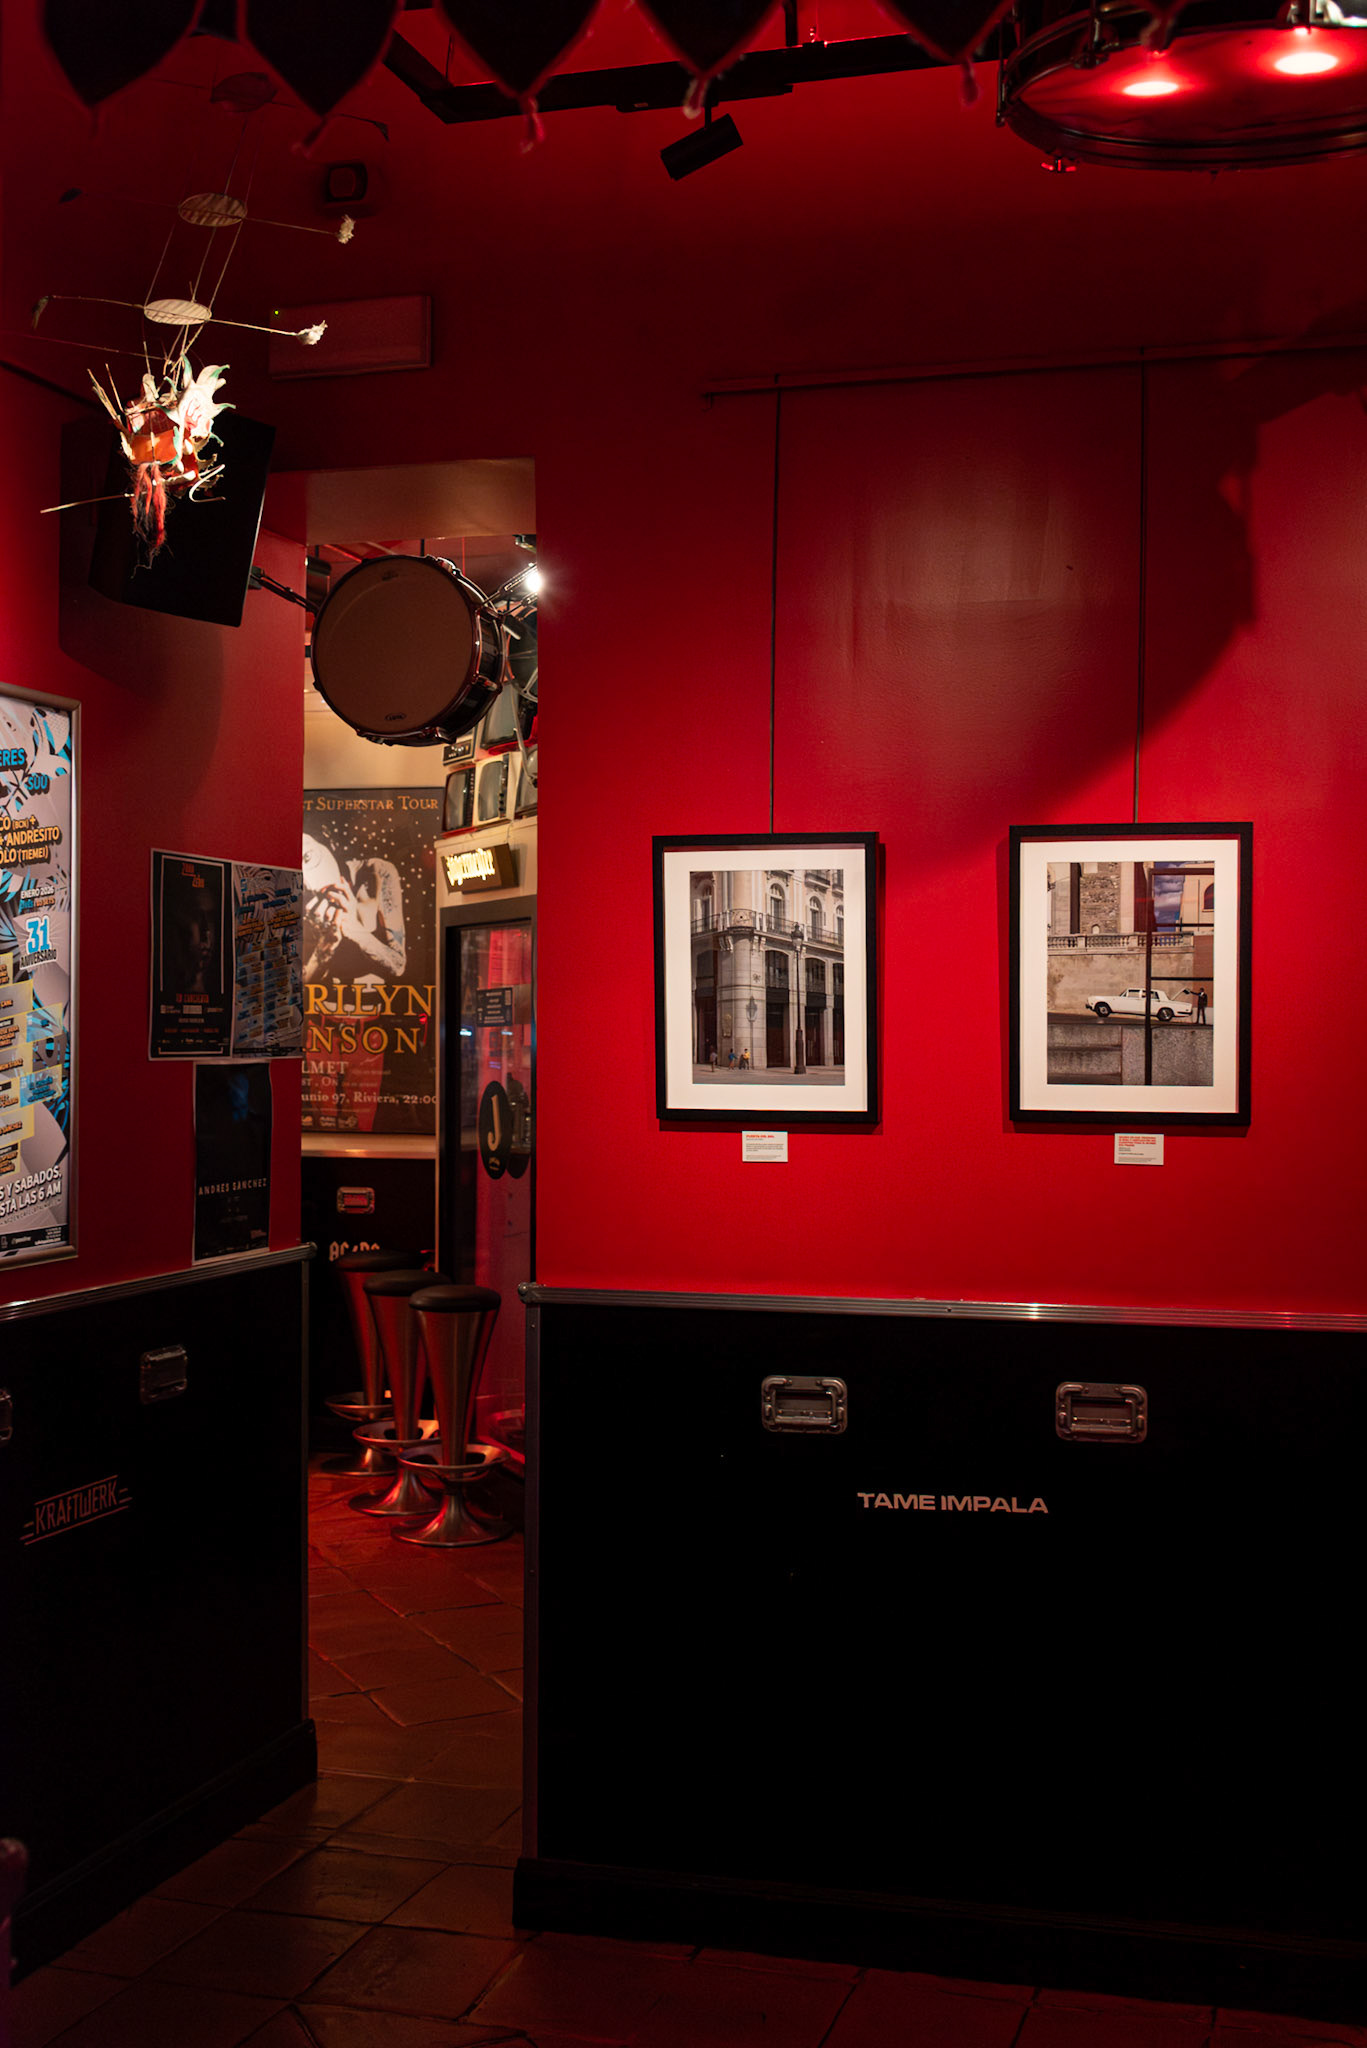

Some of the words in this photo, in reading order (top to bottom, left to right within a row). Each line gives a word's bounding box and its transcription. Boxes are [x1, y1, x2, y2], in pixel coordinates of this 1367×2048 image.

[0, 748, 25, 767] RES
[303, 800, 314, 811] T
[6, 826, 60, 847] ANDRESITO
[27, 917, 51, 955] 31
[20, 948, 57, 969] ANIVERSARIO
[304, 984, 436, 1017] RILYN
[302, 1026, 421, 1055] NSON
[6, 1182, 13, 1197] Y
[19, 1190, 37, 1209] LAS
[38, 1187, 45, 1201] 6
[46, 1180, 61, 1198] AM
[34, 1479, 118, 1535] KRAFTWERK
[857, 1492, 936, 1511] TAME
[940, 1494, 1049, 1514] IMPALA
